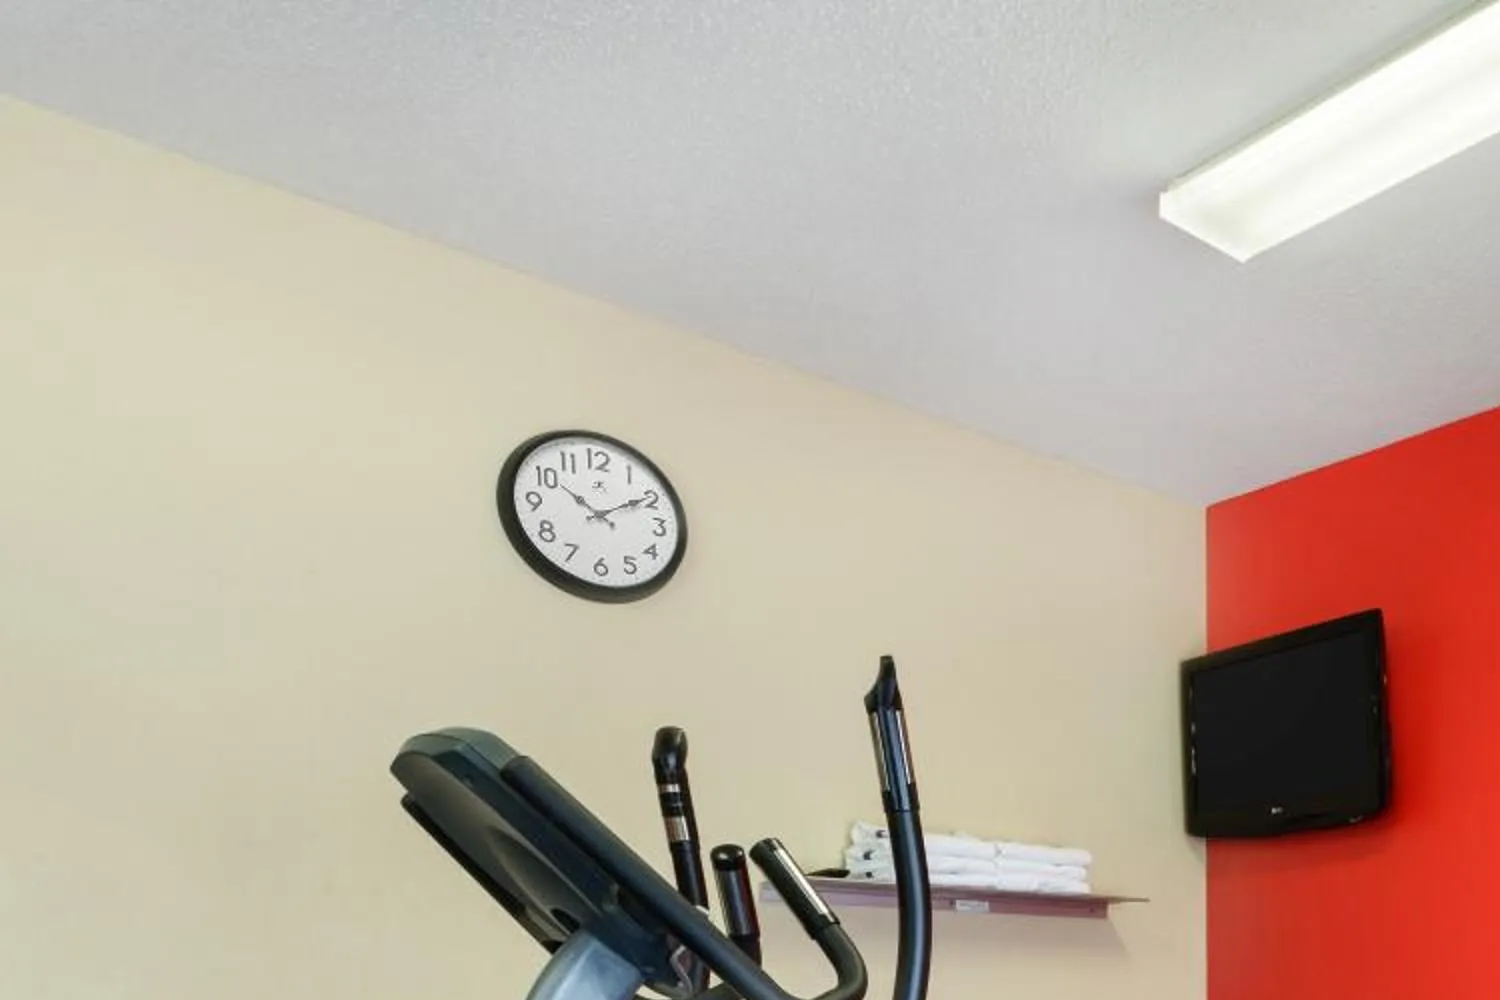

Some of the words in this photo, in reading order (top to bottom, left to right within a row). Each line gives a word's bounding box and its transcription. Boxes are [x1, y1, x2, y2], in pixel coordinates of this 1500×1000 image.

[560, 451, 576, 475] 11
[586, 447, 611, 473] 12
[535, 465, 559, 489] 10
[625, 464, 632, 485] 1
[525, 491, 543, 512] 9
[643, 489, 660, 511] 2
[538, 520, 556, 543] 8
[652, 517, 667, 537] 3
[564, 543, 581, 562] 7
[642, 543, 660, 561] 4
[593, 557, 609, 577] 6
[623, 555, 638, 575] 5
